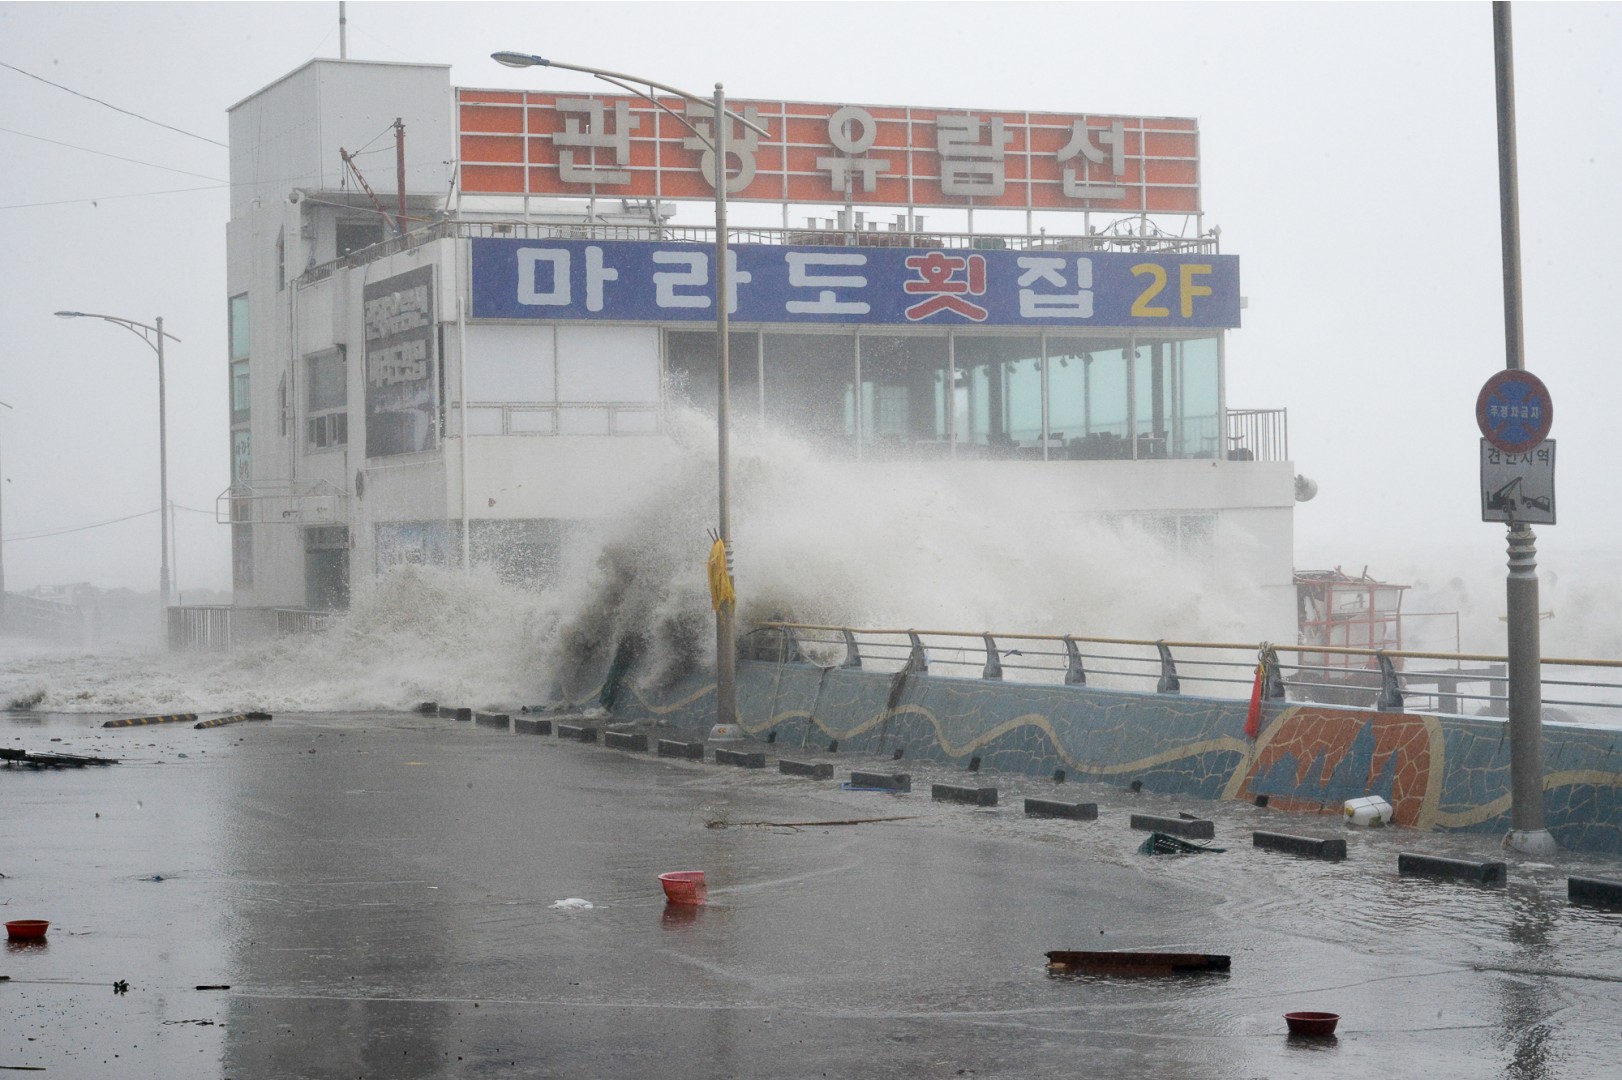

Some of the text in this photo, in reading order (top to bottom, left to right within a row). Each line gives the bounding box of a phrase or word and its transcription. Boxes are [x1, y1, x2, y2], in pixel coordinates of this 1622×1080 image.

[553, 98, 1127, 201] 관광유람선
[516, 245, 1214, 322] 마라도횟집 2F
[1490, 405, 1539, 418] 주정차금지
